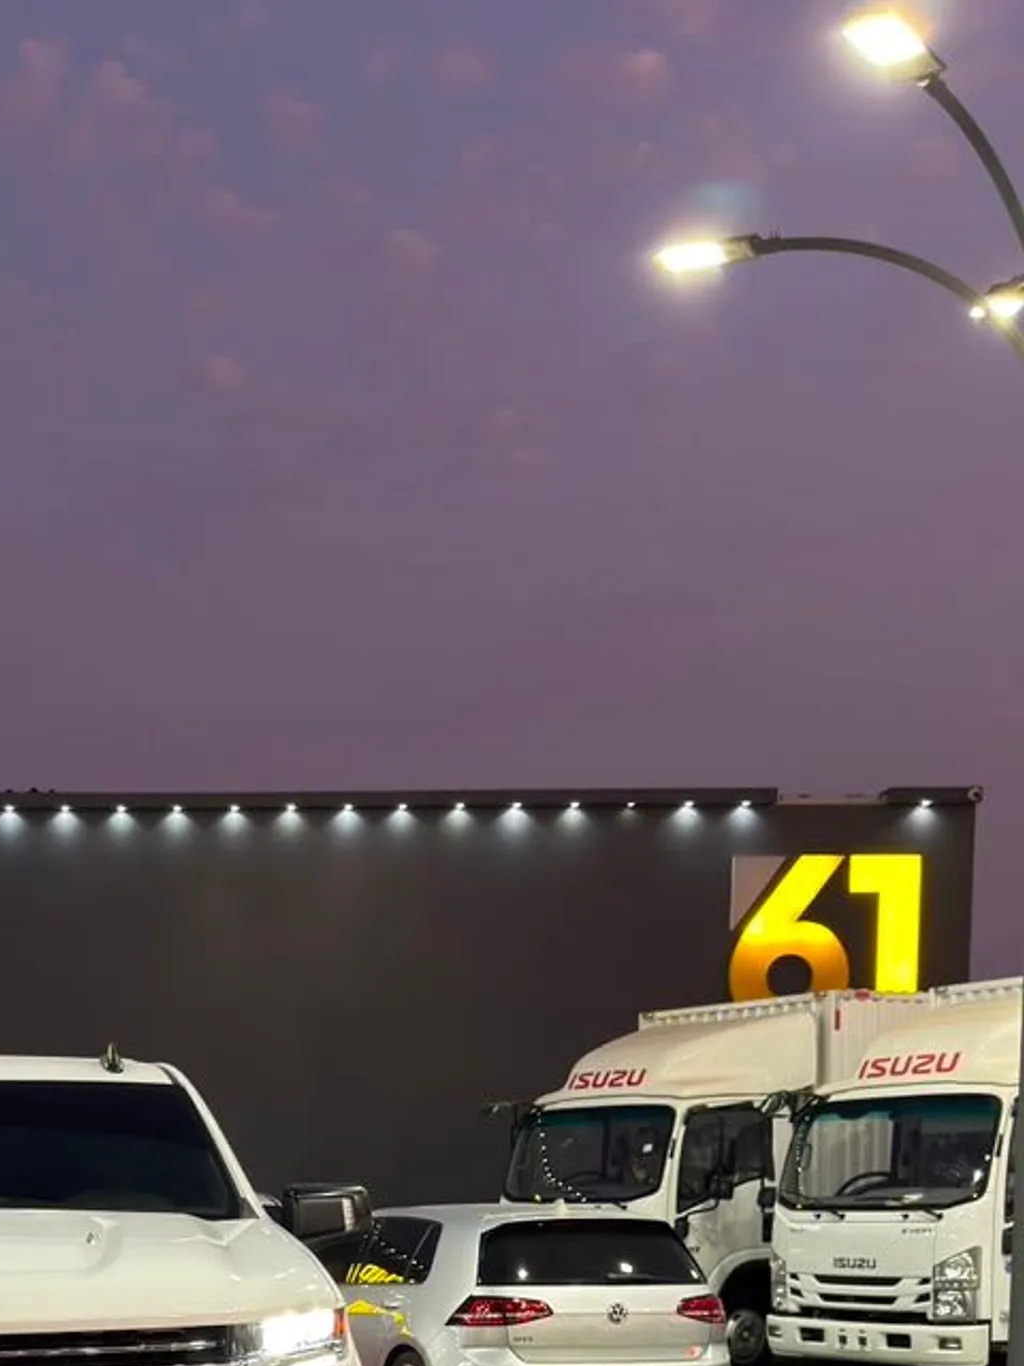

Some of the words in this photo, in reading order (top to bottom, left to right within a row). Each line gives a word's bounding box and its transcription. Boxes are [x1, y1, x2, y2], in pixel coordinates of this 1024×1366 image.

[729, 853, 923, 1002] 61
[858, 1052, 960, 1080] ISUZU
[568, 1068, 647, 1091] ISUZU
[833, 1257, 877, 1269] ISUZU
